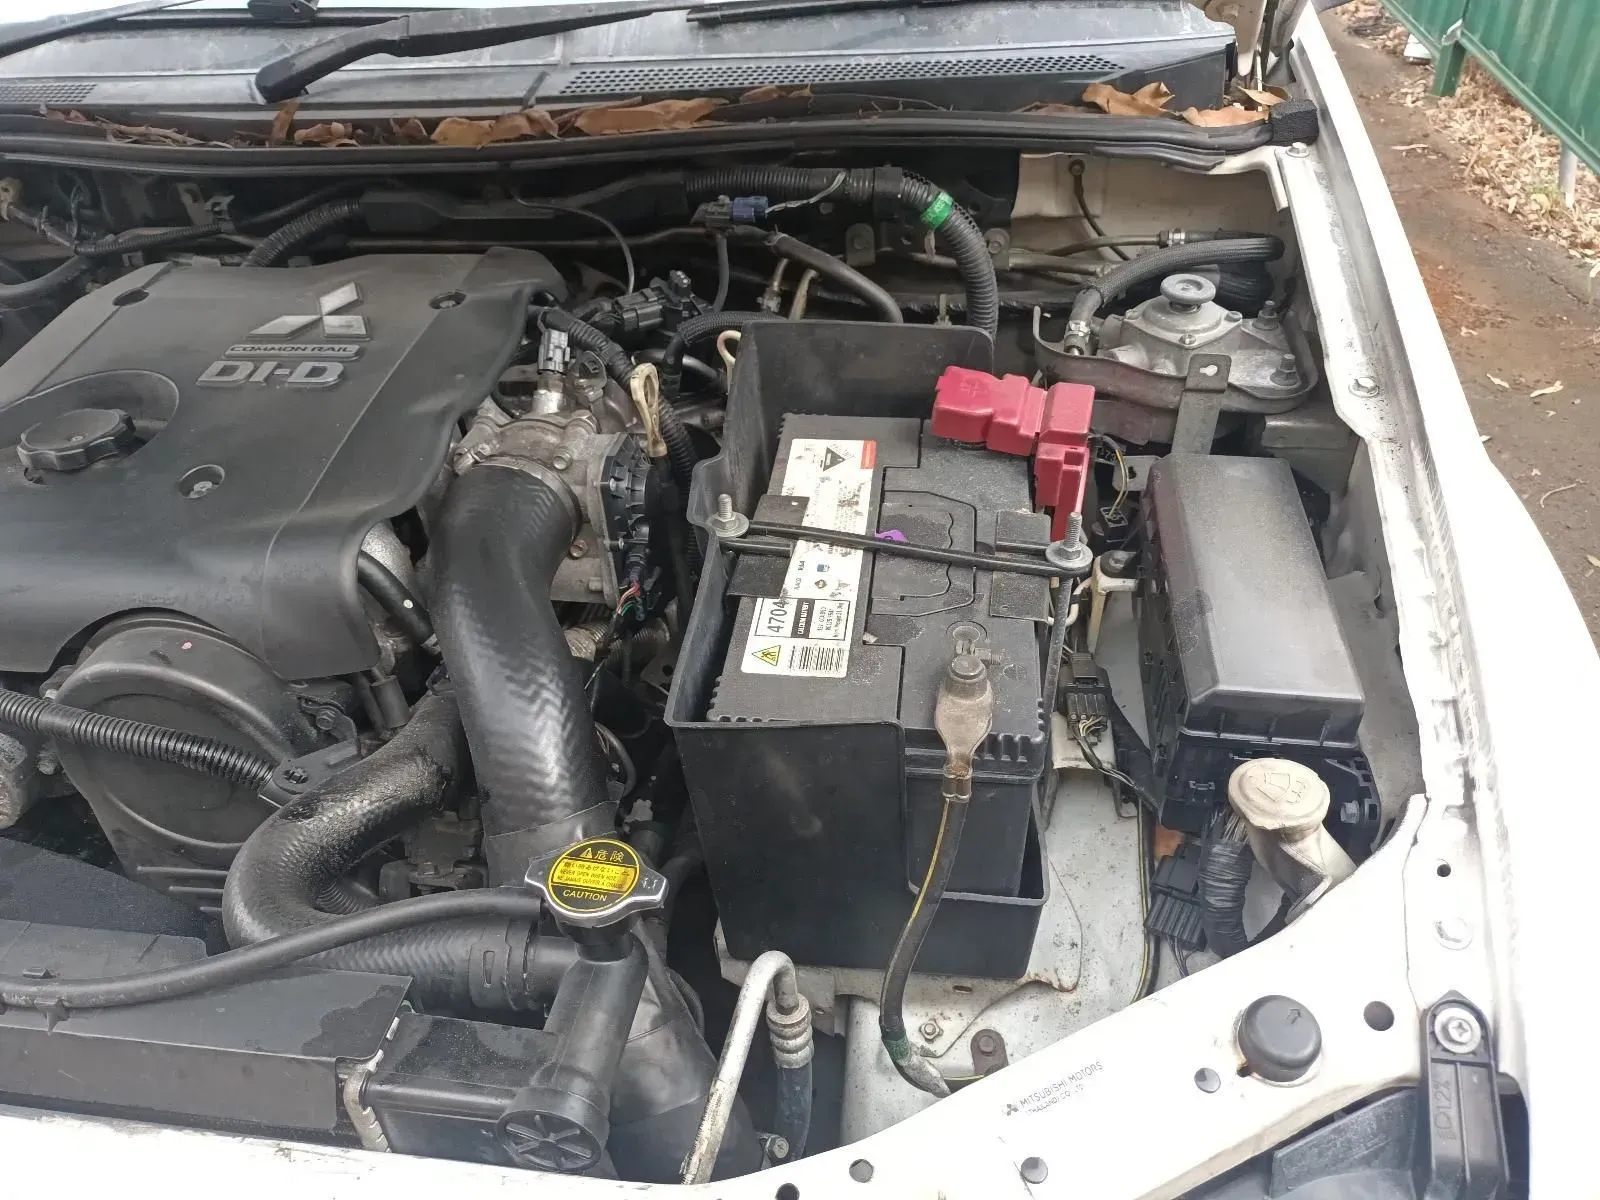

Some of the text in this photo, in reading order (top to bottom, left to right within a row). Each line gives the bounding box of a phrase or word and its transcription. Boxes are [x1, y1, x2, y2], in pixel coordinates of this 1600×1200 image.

[196, 360, 345, 387] DI-D
[594, 849, 625, 862] 危険
[563, 889, 608, 902] CAUTION
[1020, 1080, 1067, 1108] MITSUBISHI
[1068, 1060, 1103, 1081] MOTORS
